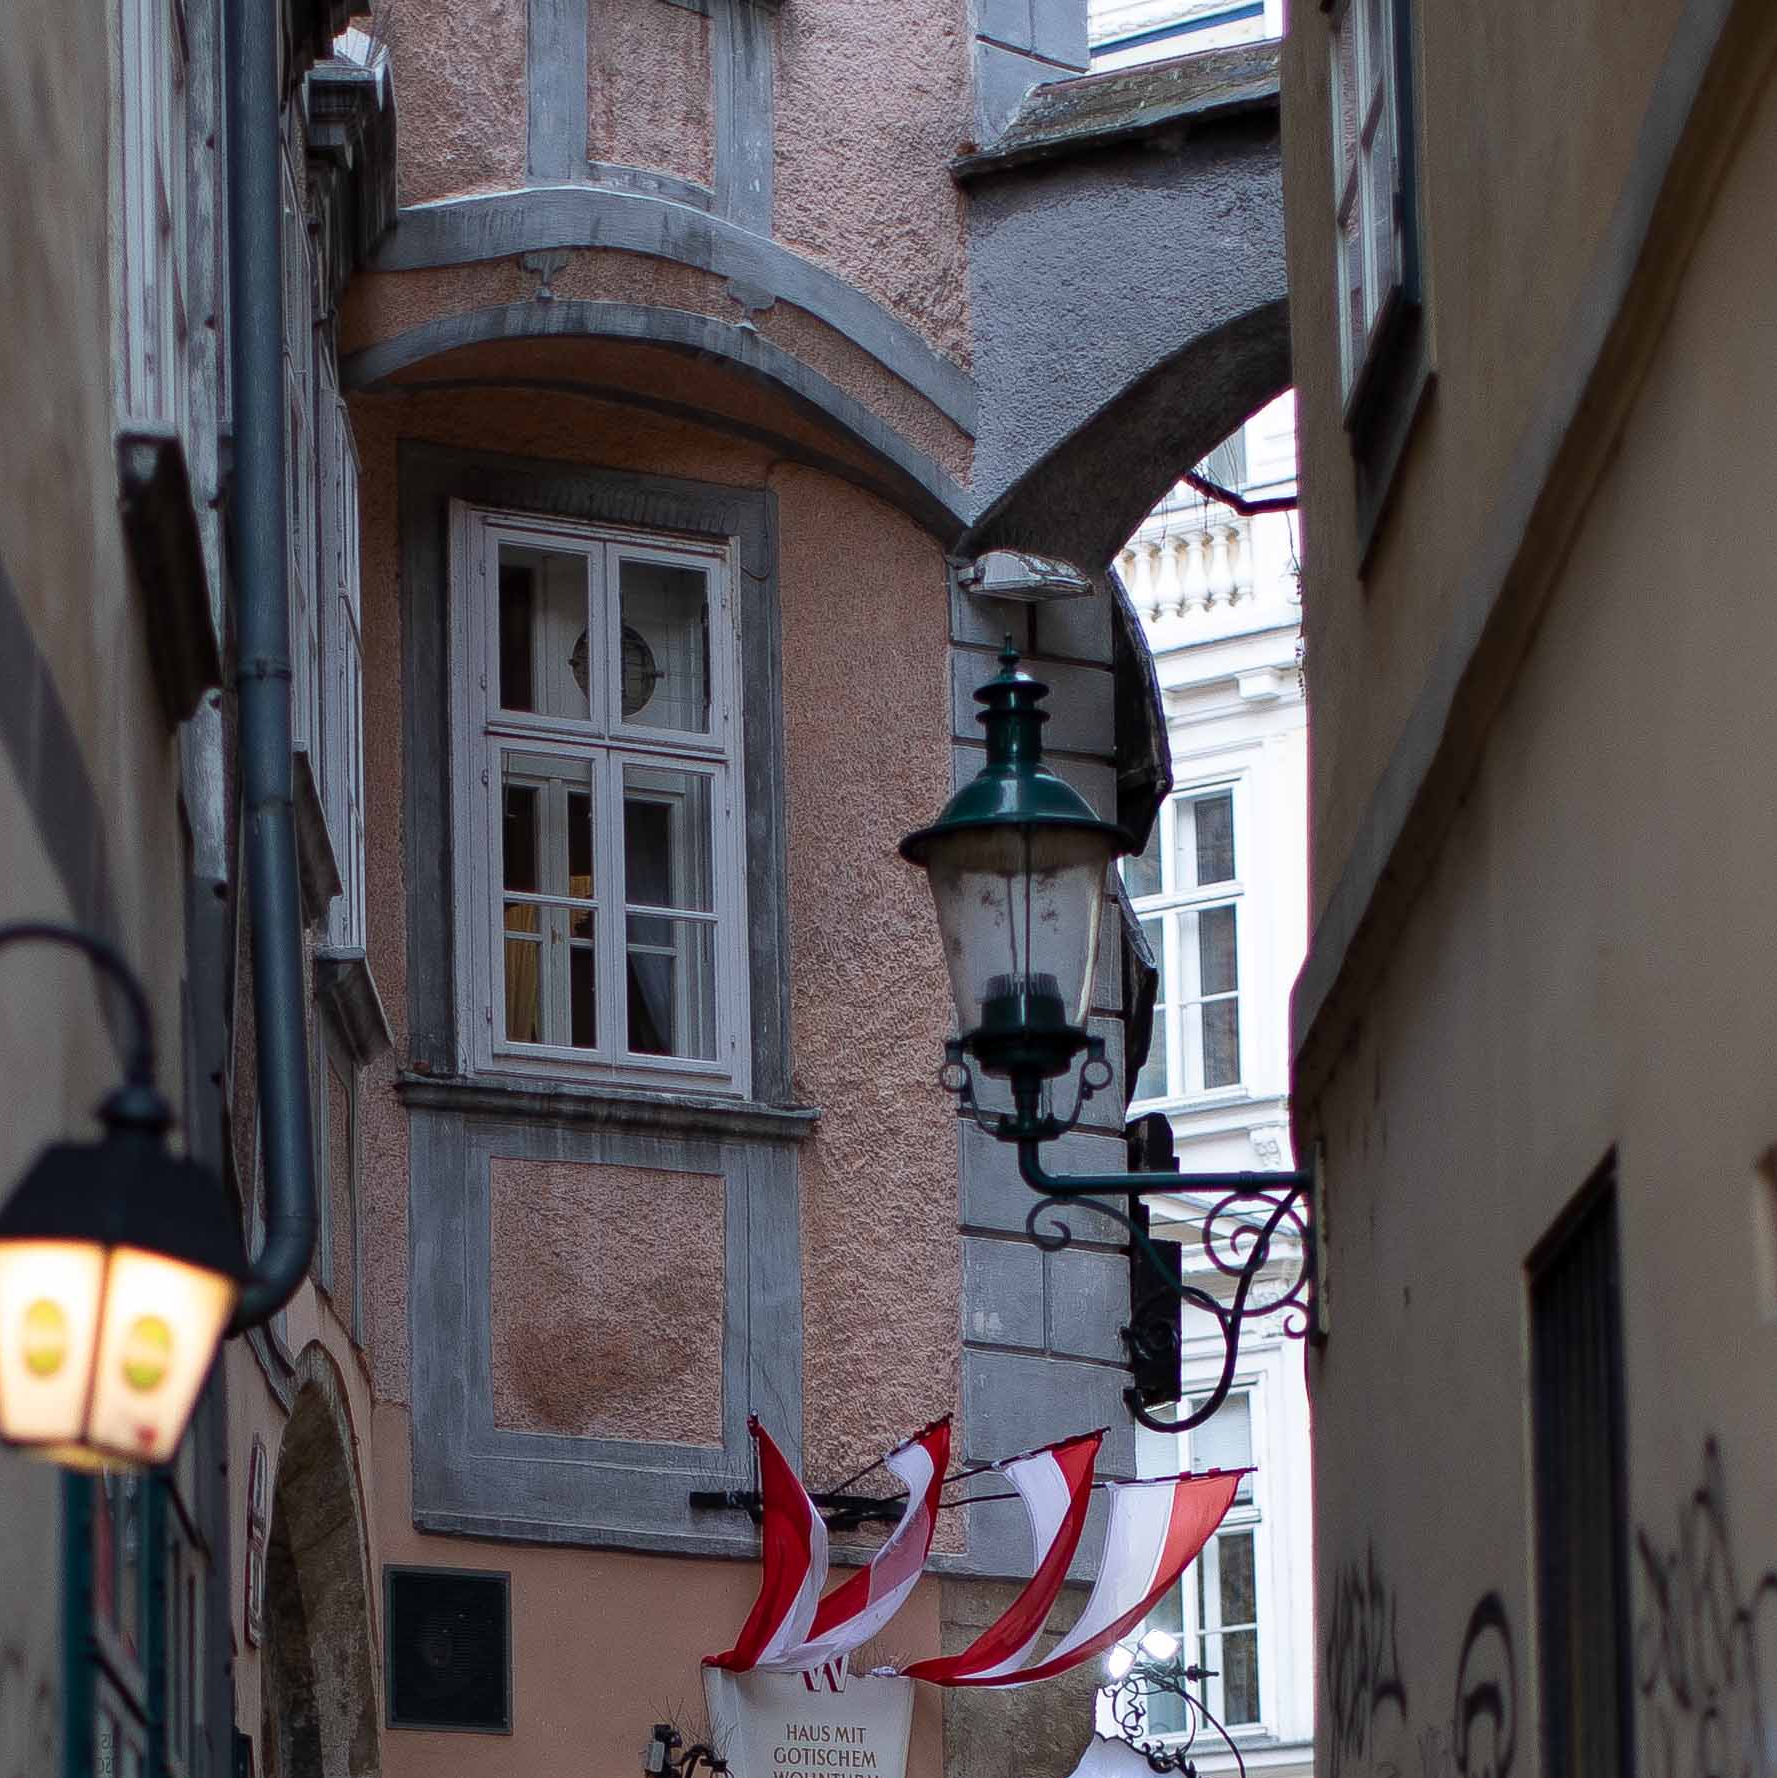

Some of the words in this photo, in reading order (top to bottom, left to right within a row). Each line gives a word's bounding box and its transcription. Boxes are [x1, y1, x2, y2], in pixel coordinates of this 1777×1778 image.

[785, 1723, 831, 1743] HAUS
[834, 1727, 867, 1745] MIT
[773, 1747, 878, 1769] GOTISCHEM
